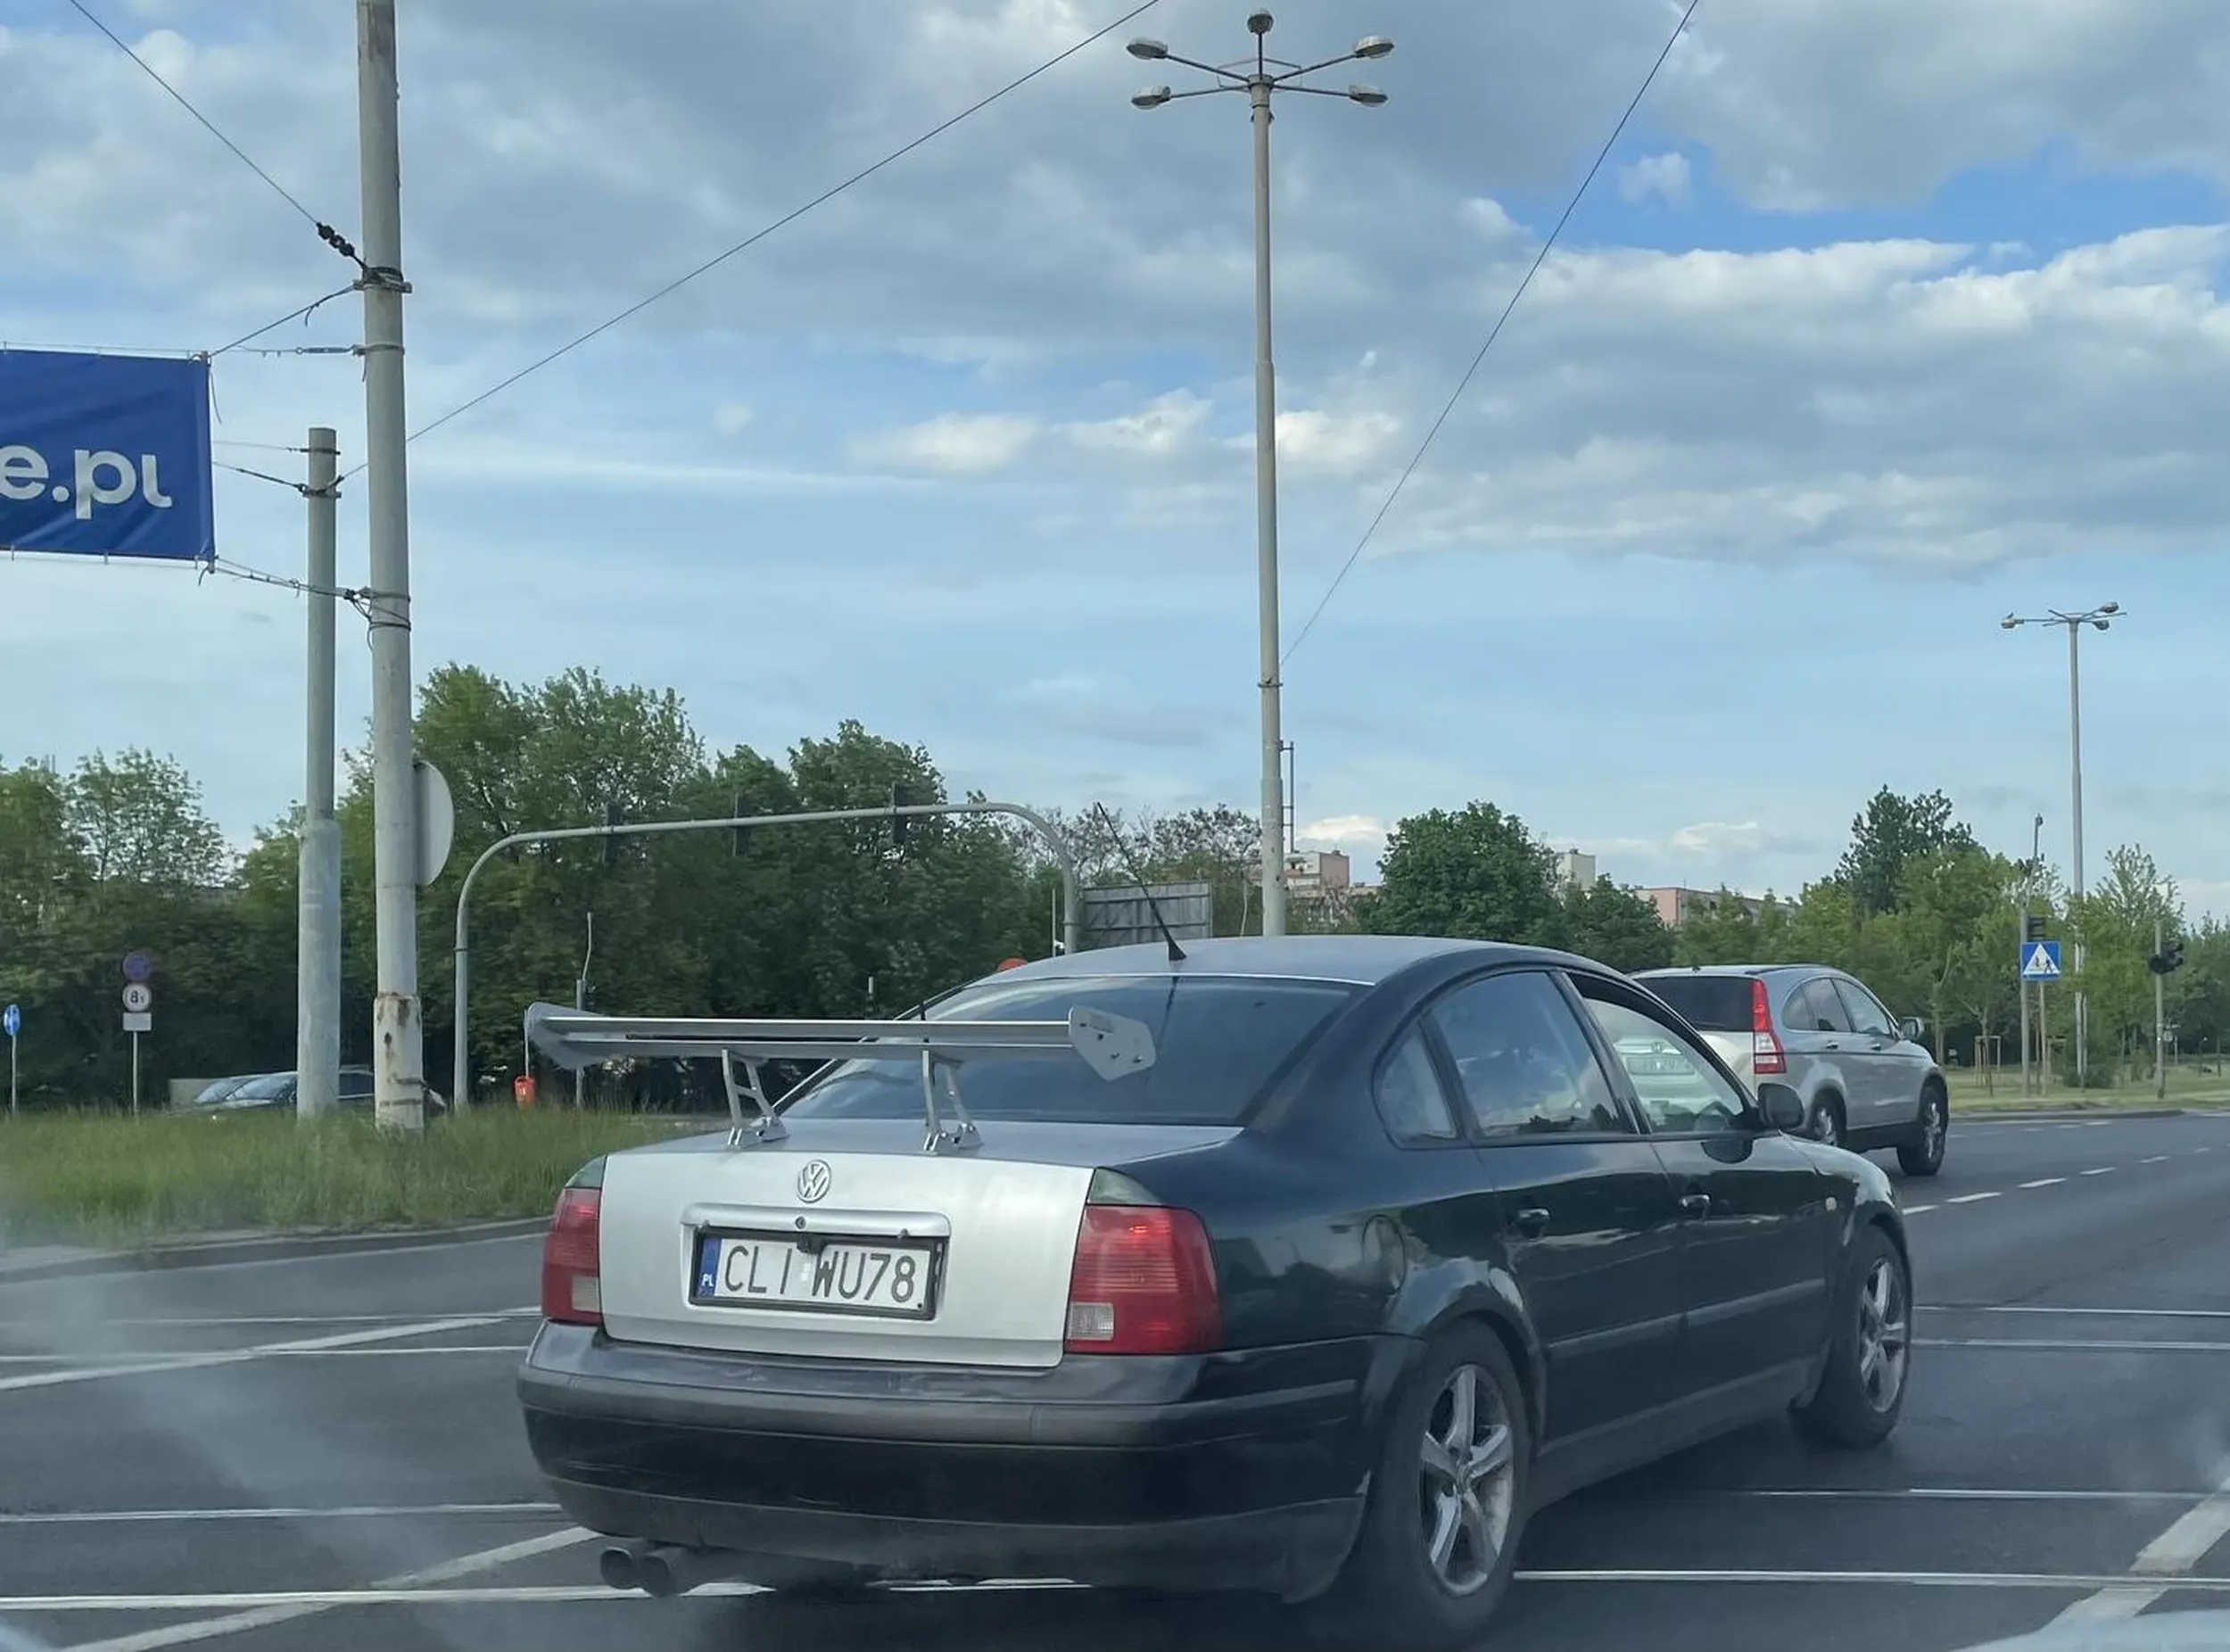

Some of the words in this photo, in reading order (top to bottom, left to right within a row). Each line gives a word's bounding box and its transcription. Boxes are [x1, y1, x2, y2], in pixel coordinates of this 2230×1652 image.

[702, 1273, 714, 1286] PL
[724, 1245, 792, 1294] CLI
[811, 1251, 916, 1303] WU78
